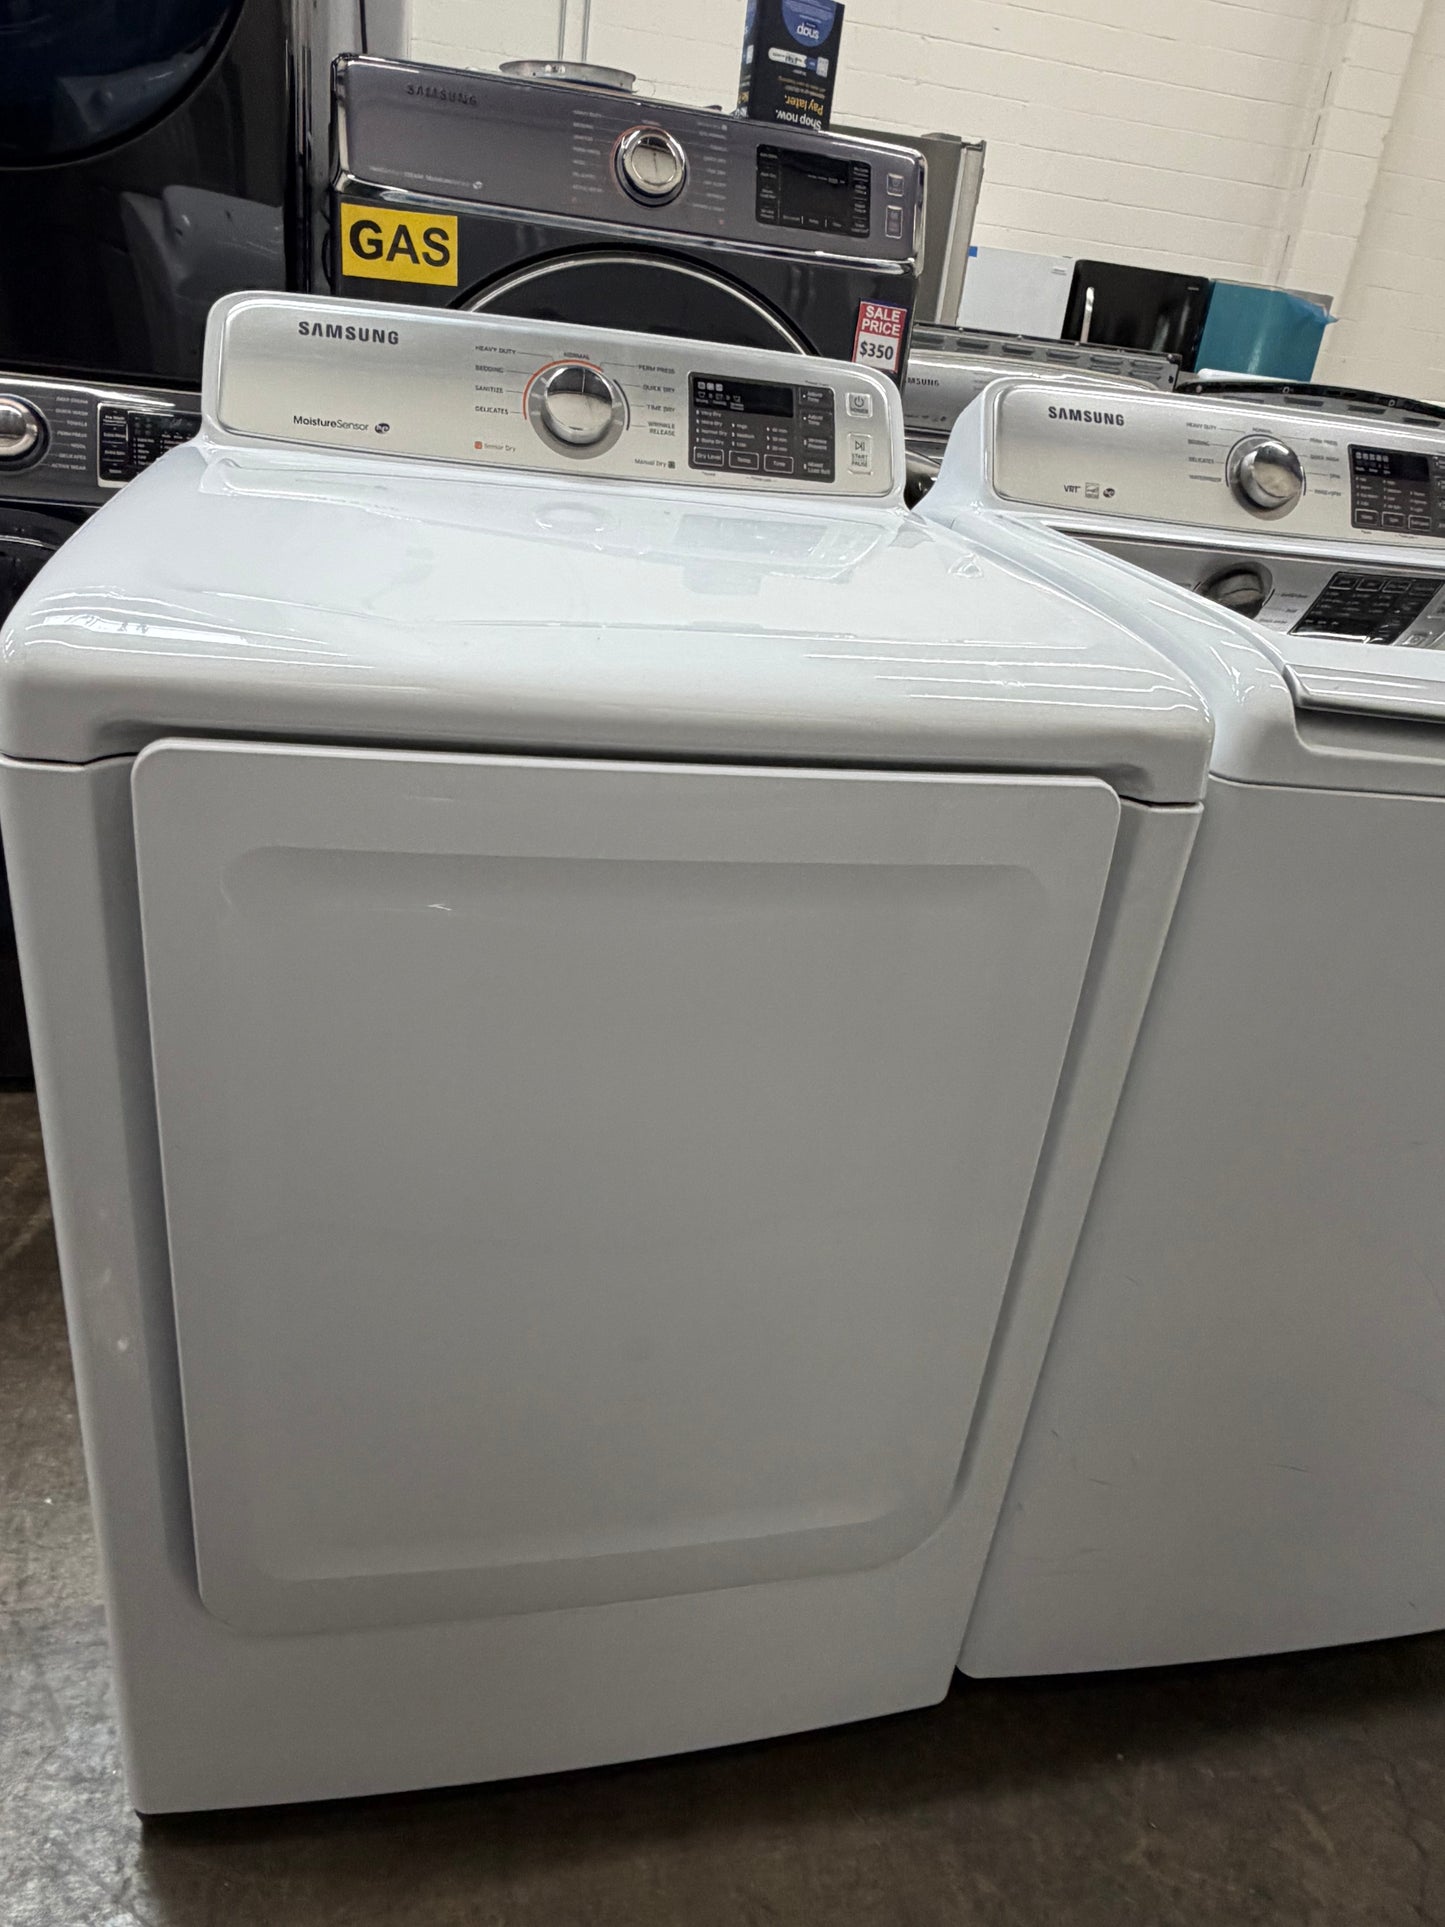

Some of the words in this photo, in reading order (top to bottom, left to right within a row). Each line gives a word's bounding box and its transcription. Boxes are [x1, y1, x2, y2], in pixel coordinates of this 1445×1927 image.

[796, 22, 819, 40] snap
[407, 84, 478, 106] SAMSUNG
[784, 94, 808, 110] later.
[808, 99, 824, 116] Pay
[775, 109, 798, 124] now.
[799, 113, 822, 130] Shop
[350, 220, 450, 267] GAS
[865, 305, 901, 322] SALE
[298, 321, 399, 345] SAMSUNG
[861, 318, 901, 336] PRICE
[563, 352, 590, 360] NORMAL
[860, 340, 894, 360] $350
[475, 364, 504, 374] BEDDING
[638, 364, 656, 372] PERM
[656, 366, 676, 374] PRESS
[475, 385, 504, 394] SANITIZE
[642, 384, 662, 392] QUICK
[475, 406, 509, 416] DELICATES
[1048, 406, 1124, 426] SAMSUNG
[293, 415, 369, 431] MoistureSensor
[648, 422, 676, 430] WRINKLE
[1186, 422, 1203, 430] HEAVY
[649, 428, 676, 436] RELEASE
[504, 444, 516, 452] Dry
[1188, 456, 1214, 464] DELICATES
